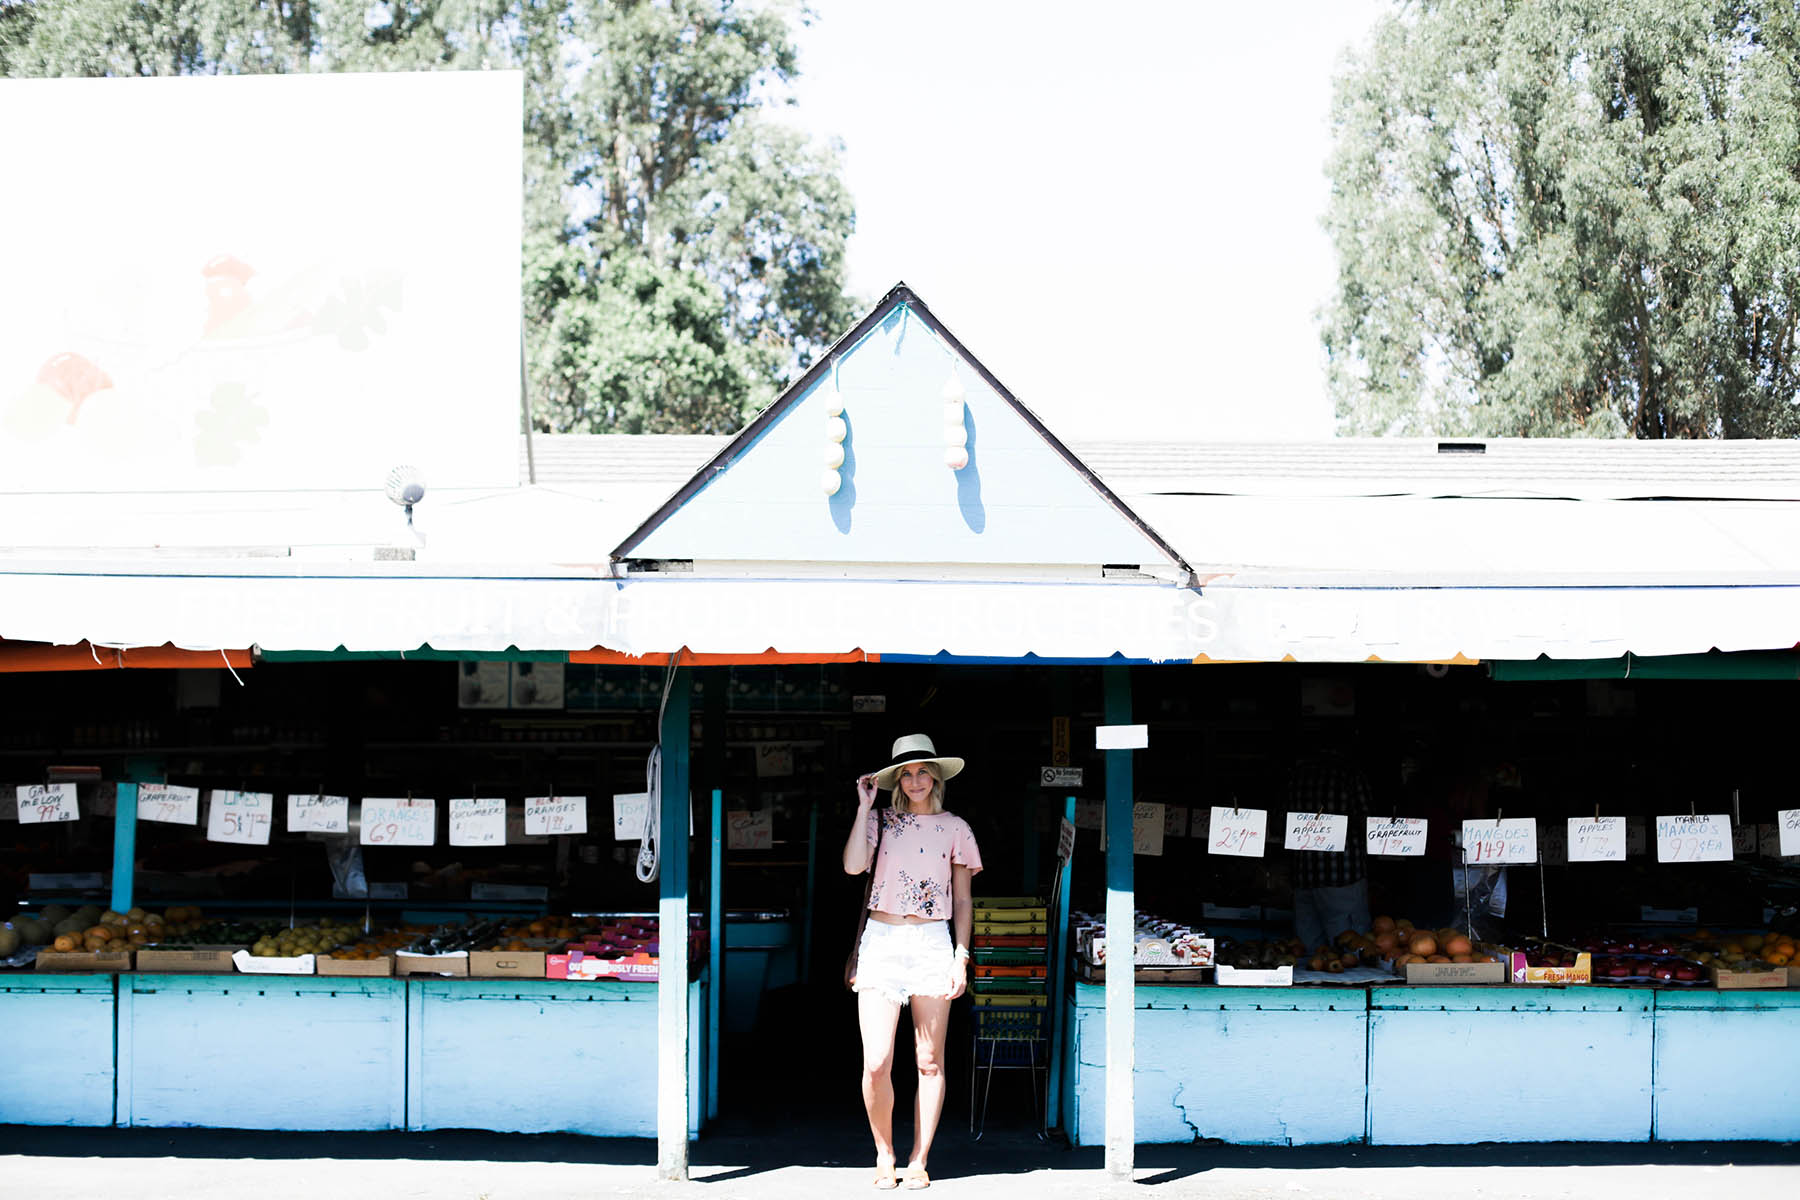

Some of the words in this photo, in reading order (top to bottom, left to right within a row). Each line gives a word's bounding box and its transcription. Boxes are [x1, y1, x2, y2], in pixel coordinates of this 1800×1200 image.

[176, 591, 347, 633] FRESH
[366, 592, 521, 634] FRUIT
[543, 592, 587, 634] &
[606, 592, 867, 637] PRODUCE
[911, 598, 1216, 642] GROCERIES
[21, 794, 64, 808] MELON
[139, 792, 192, 803] GRAPEFRUIT
[526, 803, 576, 816] ORANGES
[58, 812, 70, 820] LB
[1674, 815, 1710, 825] MANILA
[223, 812, 237, 836] 5
[1577, 823, 1614, 834] APPLES
[1292, 826, 1332, 836] APPLES
[1368, 829, 1423, 841] GRAPEFRUIT
[1464, 826, 1529, 842] MANGOES
[1657, 822, 1719, 839] MANGOS
[1215, 826, 1233, 849] 2
[1543, 972, 1565, 982] FRESH
[1566, 972, 1589, 982] MANGO
